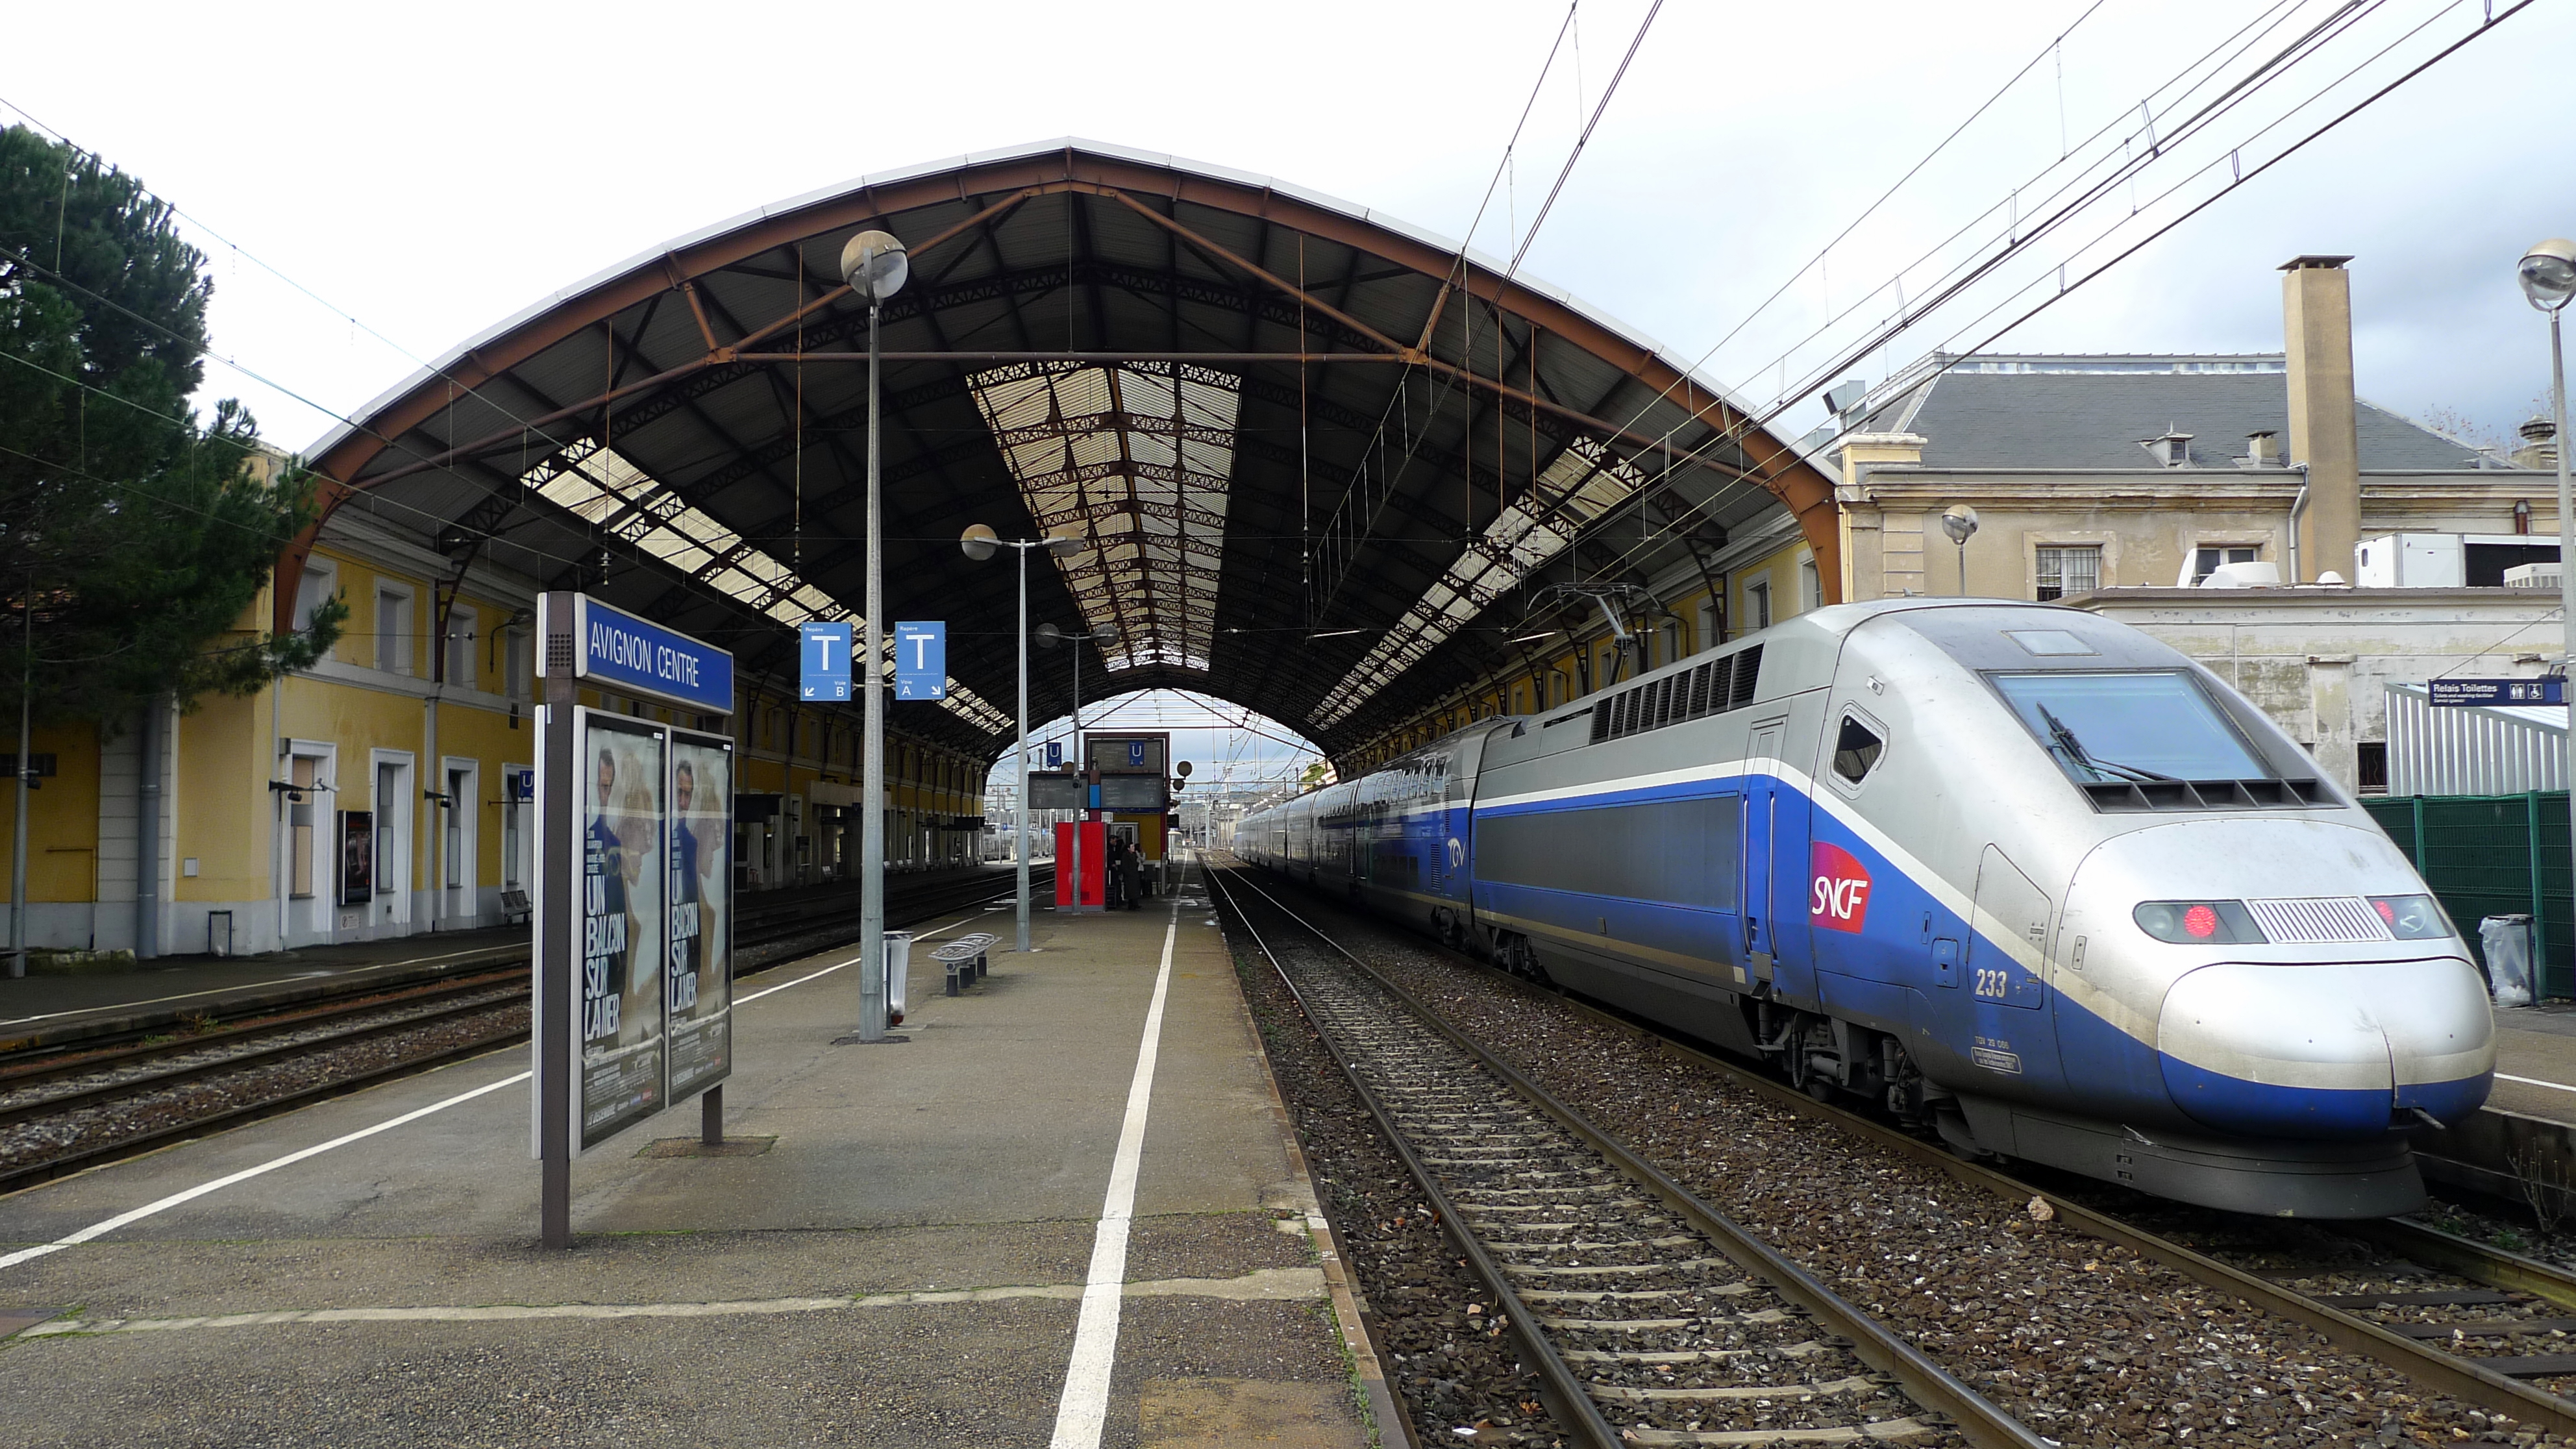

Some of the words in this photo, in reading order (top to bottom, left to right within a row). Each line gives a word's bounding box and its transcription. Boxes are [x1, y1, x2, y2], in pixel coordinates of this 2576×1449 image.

[591, 621, 652, 674] AVIGNON
[657, 645, 700, 688] CENTRE
[811, 635, 841, 671] T
[906, 634, 935, 669] T
[836, 686, 844, 697] B
[902, 686, 911, 695] A
[2433, 684, 2460, 692] Relais
[2460, 684, 2497, 692] Toilettes
[1050, 746, 1059, 758] U
[1132, 745, 1141, 757] U
[523, 774, 533, 787] U
[587, 874, 605, 915] UN
[1811, 876, 1868, 919] SNCF
[586, 913, 625, 958] BALCON
[671, 902, 699, 941] BALCON
[671, 939, 687, 976] SUR
[586, 956, 608, 1000] SUR
[1975, 969, 2007, 998] 233
[1974, 1035, 1986, 1045] TGV
